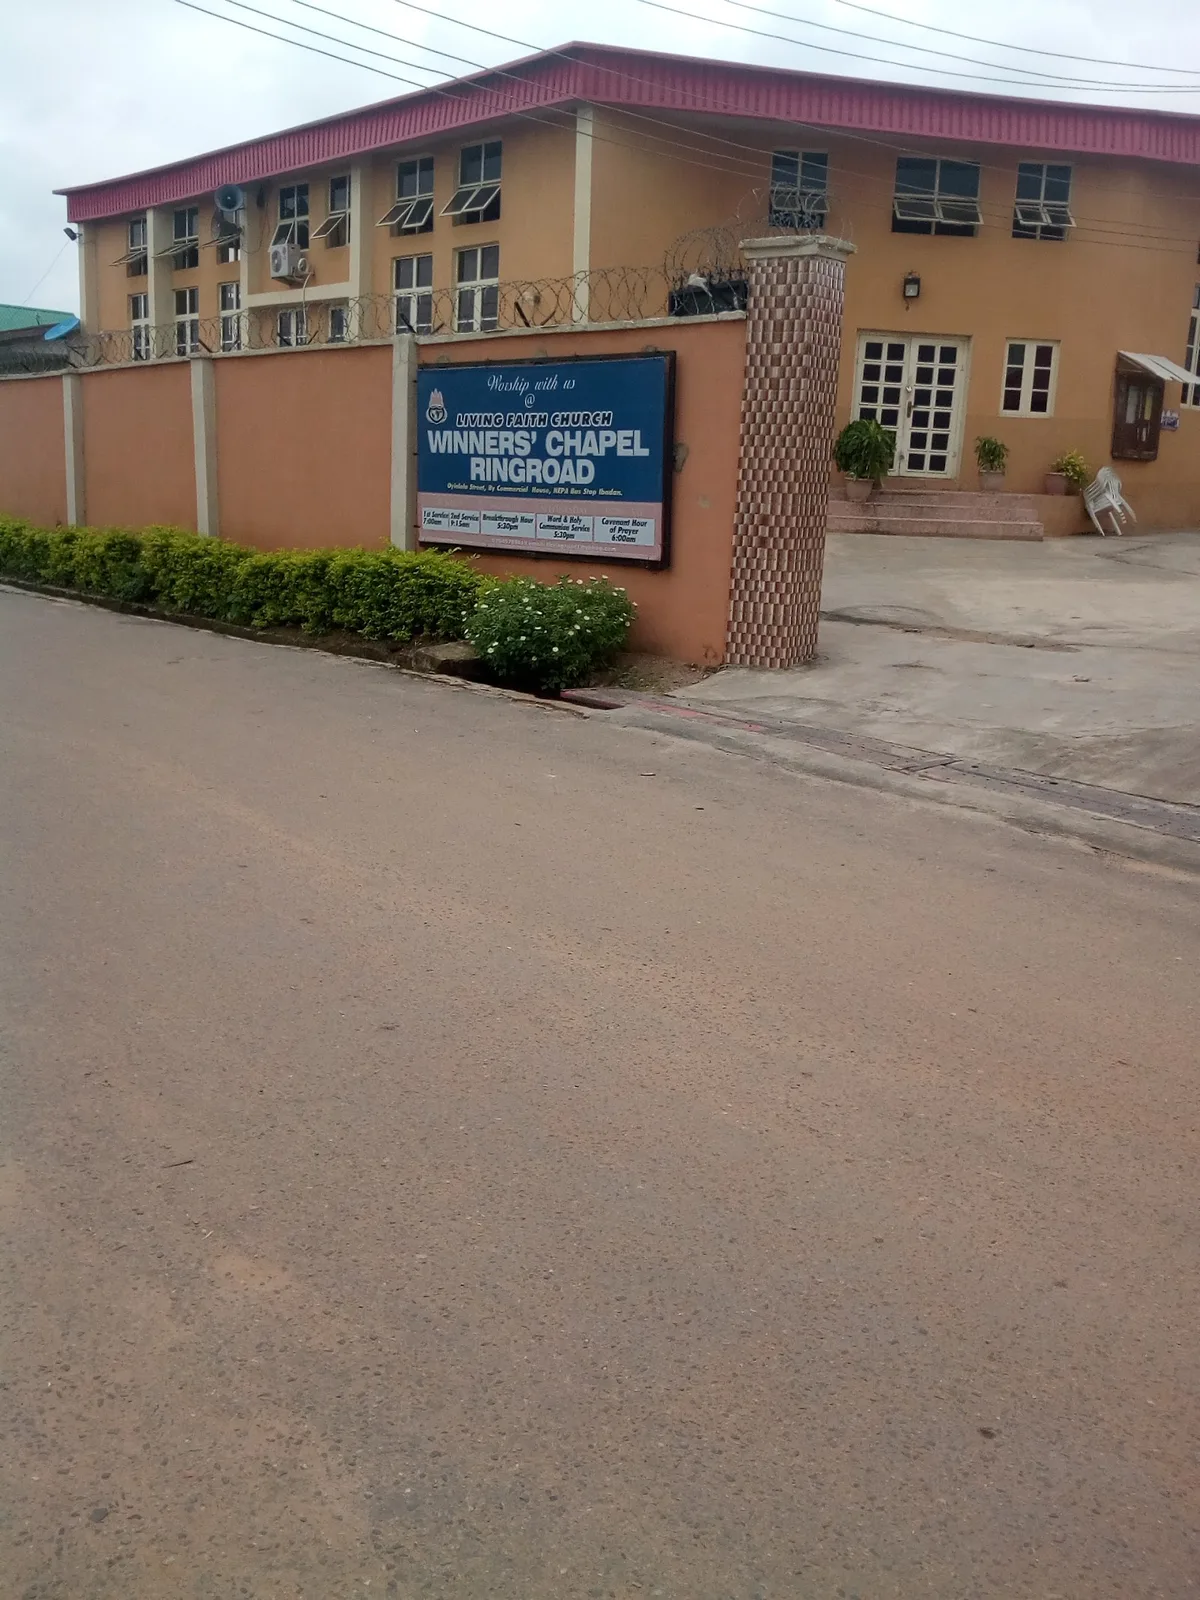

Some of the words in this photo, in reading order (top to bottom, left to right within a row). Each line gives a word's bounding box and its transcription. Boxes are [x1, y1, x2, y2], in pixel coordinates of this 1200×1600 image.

[487, 374, 529, 396] Worship
[535, 374, 558, 391] with
[563, 379, 576, 390] us
[524, 393, 536, 408] @
[456, 413, 504, 428] LIVING
[506, 412, 548, 428] FAITH
[550, 411, 613, 428] CHURCH
[427, 429, 537, 454] WINNERS'
[545, 429, 650, 457] CHAPEL
[470, 457, 595, 485] RINGROAD
[469, 483, 487, 492] Street,
[496, 484, 529, 493] Commercial
[582, 487, 597, 496] Stop
[432, 511, 449, 519] Service
[450, 512, 460, 520] 2nd
[461, 513, 479, 521] Service
[482, 513, 519, 523] Breakthrough
[520, 516, 534, 524] Hour
[547, 515, 562, 523] Word
[569, 516, 582, 525] Holy
[497, 522, 519, 531] 5:30pm
[601, 517, 630, 526] Covenant
[631, 519, 647, 527] Hour
[539, 522, 570, 531] Communion
[571, 524, 590, 533] Service
[609, 526, 616, 534] of
[617, 526, 639, 536] Prayer
[553, 531, 575, 540] 5:30pm
[611, 535, 636, 543] 6:00am
